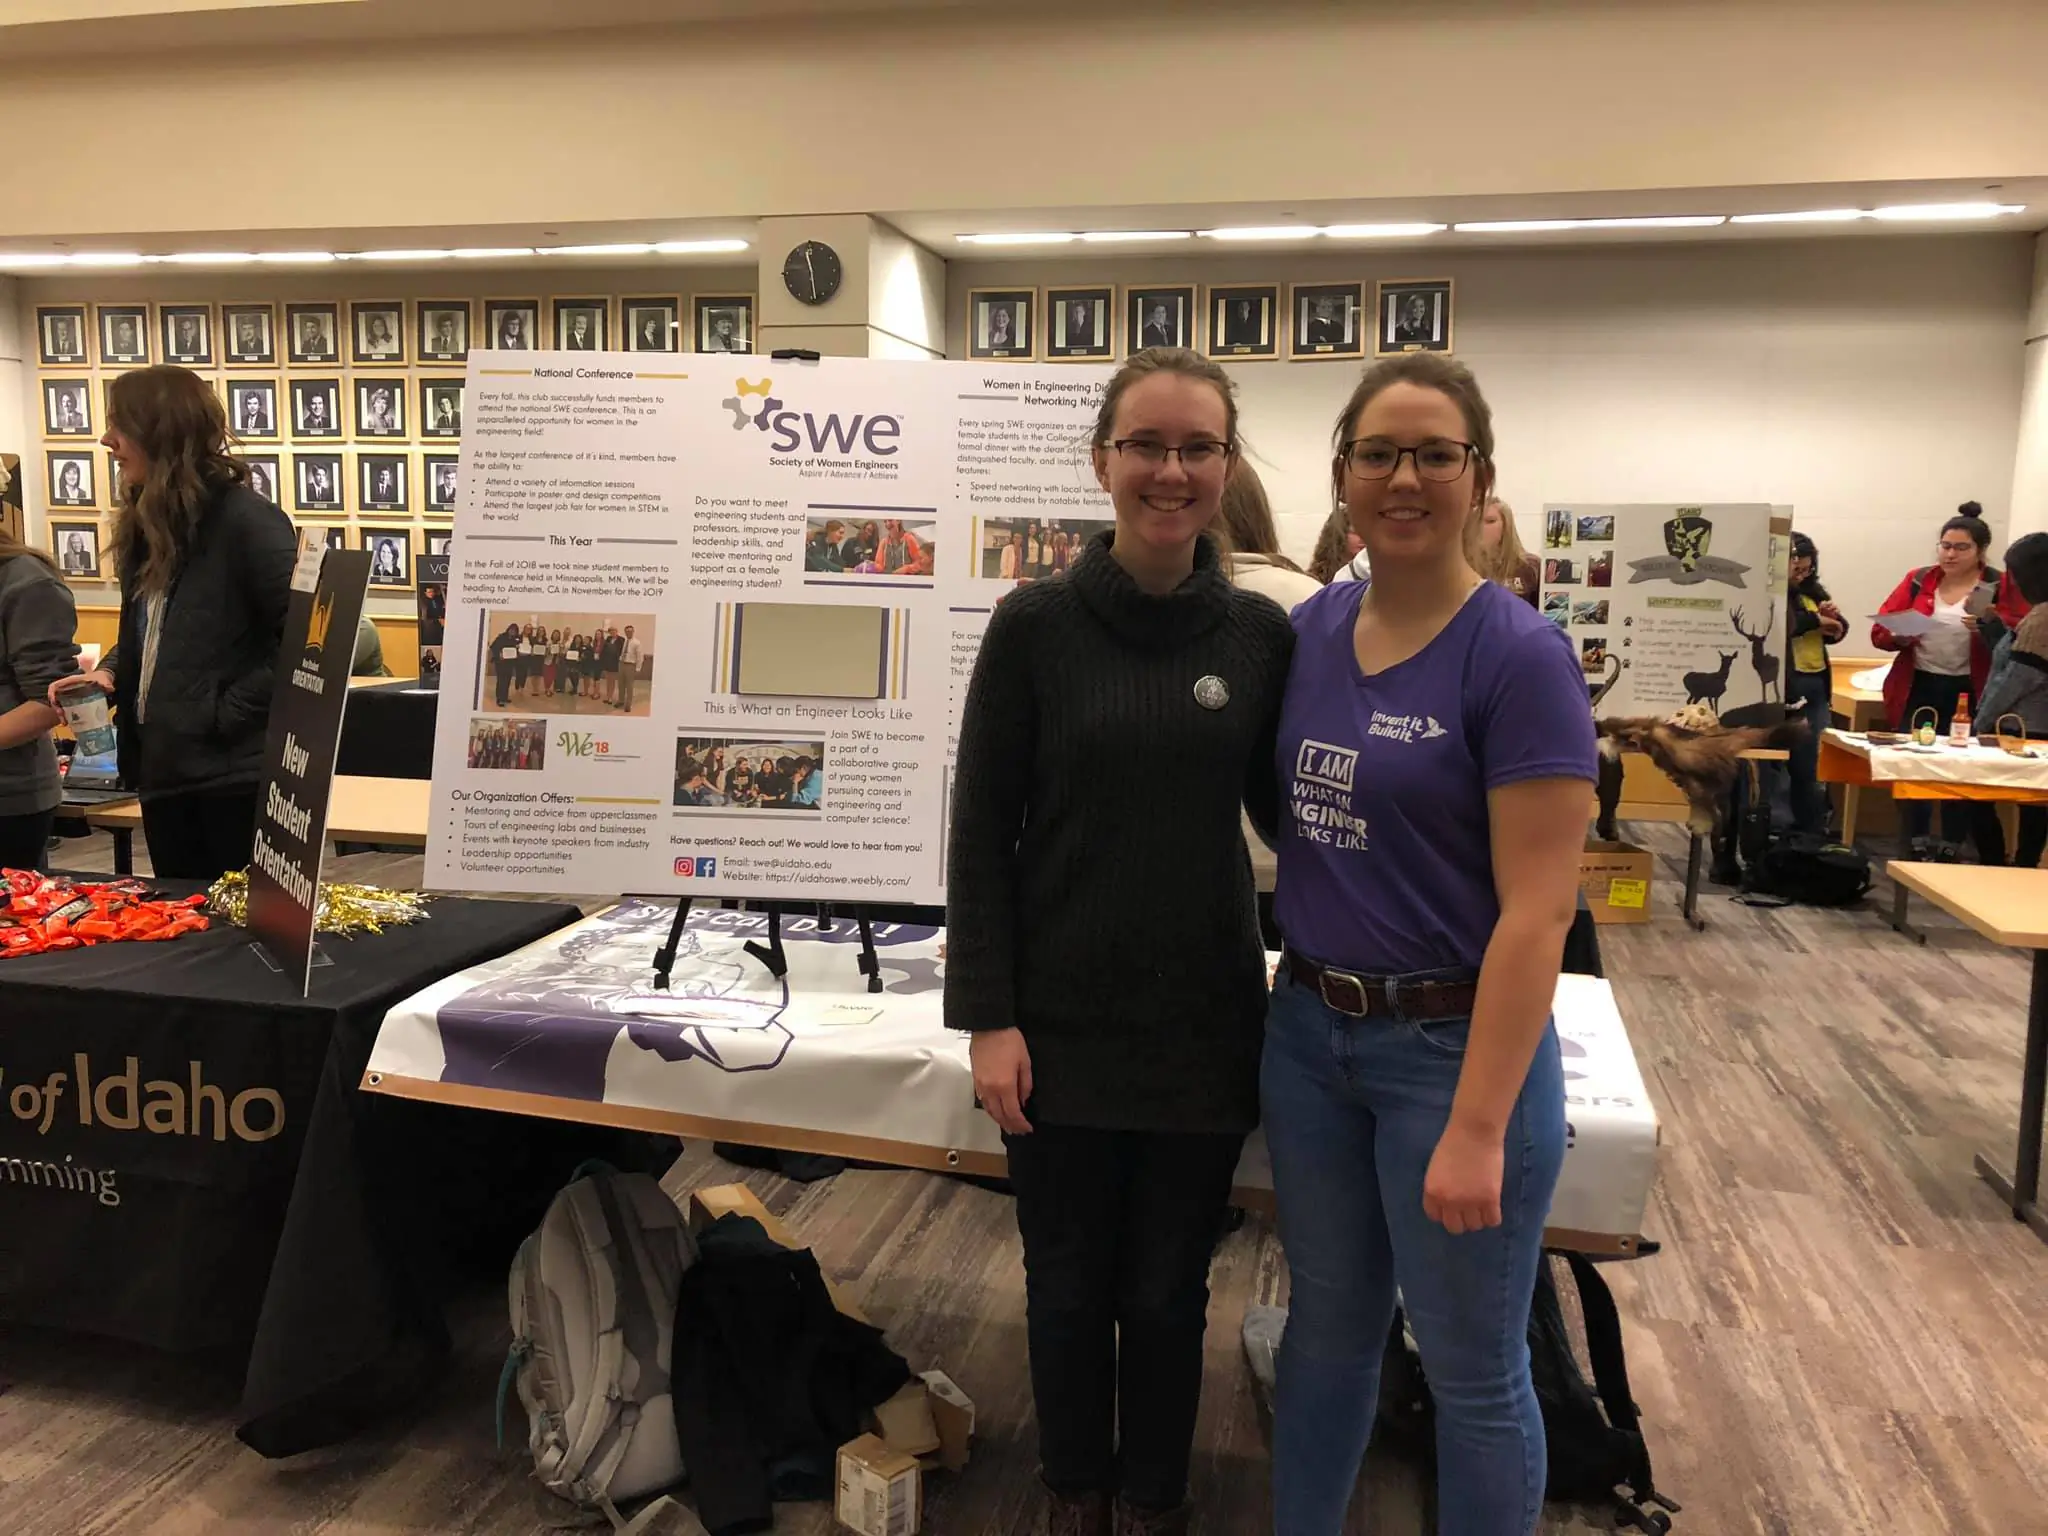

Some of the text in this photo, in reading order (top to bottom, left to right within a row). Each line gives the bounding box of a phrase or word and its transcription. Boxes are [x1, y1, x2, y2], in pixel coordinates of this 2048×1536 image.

[534, 367, 634, 380] National Conference
[983, 378, 1020, 390] Women
[1023, 380, 1032, 391] in
[1034, 380, 1091, 394] Engineering
[1024, 395, 1077, 408] Networking
[769, 456, 899, 471] Society of Women Engineers
[485, 477, 512, 486] Attend
[520, 479, 548, 488] variety
[547, 478, 558, 487] of
[559, 478, 603, 488] information
[604, 481, 635, 489] sessions
[695, 495, 788, 508] Do you want to meet
[970, 493, 1111, 506] Keynote address by notable female
[693, 509, 805, 523] engineering students and
[743, 525, 779, 538] improve
[781, 527, 801, 537] your
[549, 534, 593, 546] This Year
[692, 535, 740, 548] leadership
[765, 538, 784, 548] and
[691, 550, 793, 563] receive mentoring and
[690, 563, 724, 577] support
[747, 564, 780, 575] female
[689, 576, 782, 590] engineering student?
[292, 668, 325, 695] ORIENTATION
[703, 700, 913, 721] This is What an Engineer Looks Like
[1371, 709, 1424, 733] Invent it
[829, 728, 925, 743] Join SWE to become
[1367, 723, 1399, 740] Build
[281, 731, 310, 779] New
[594, 741, 610, 754] 18
[829, 744, 879, 756] a part of a
[829, 757, 919, 772] collaborative group
[1303, 747, 1351, 783] I AM
[828, 771, 902, 784] of young women
[451, 789, 574, 804] Our Organization Offers:
[827, 786, 912, 798] pursuing careers in
[1293, 781, 1333, 803] WHAT
[267, 780, 312, 845] Student
[826, 798, 902, 812] engineering and
[465, 806, 658, 823] Mentoring and advice from upperclassmen
[826, 814, 910, 825] computer science!
[463, 818, 646, 835] Tours of engineering labs and businesses
[462, 833, 650, 850] Events with keynote speakers from industry
[669, 834, 923, 853] Have questions? Reach out! We would love to hear from you!
[462, 847, 572, 862] Leadership opportunities
[253, 828, 313, 911] Orientation
[460, 862, 565, 875] Volunteer opportunities
[723, 855, 832, 870] Email: swe@uidaho.edu
[722, 869, 911, 885] Website: https://uidahoswe.weebly.com/
[9, 1052, 286, 1143] of Idaho
